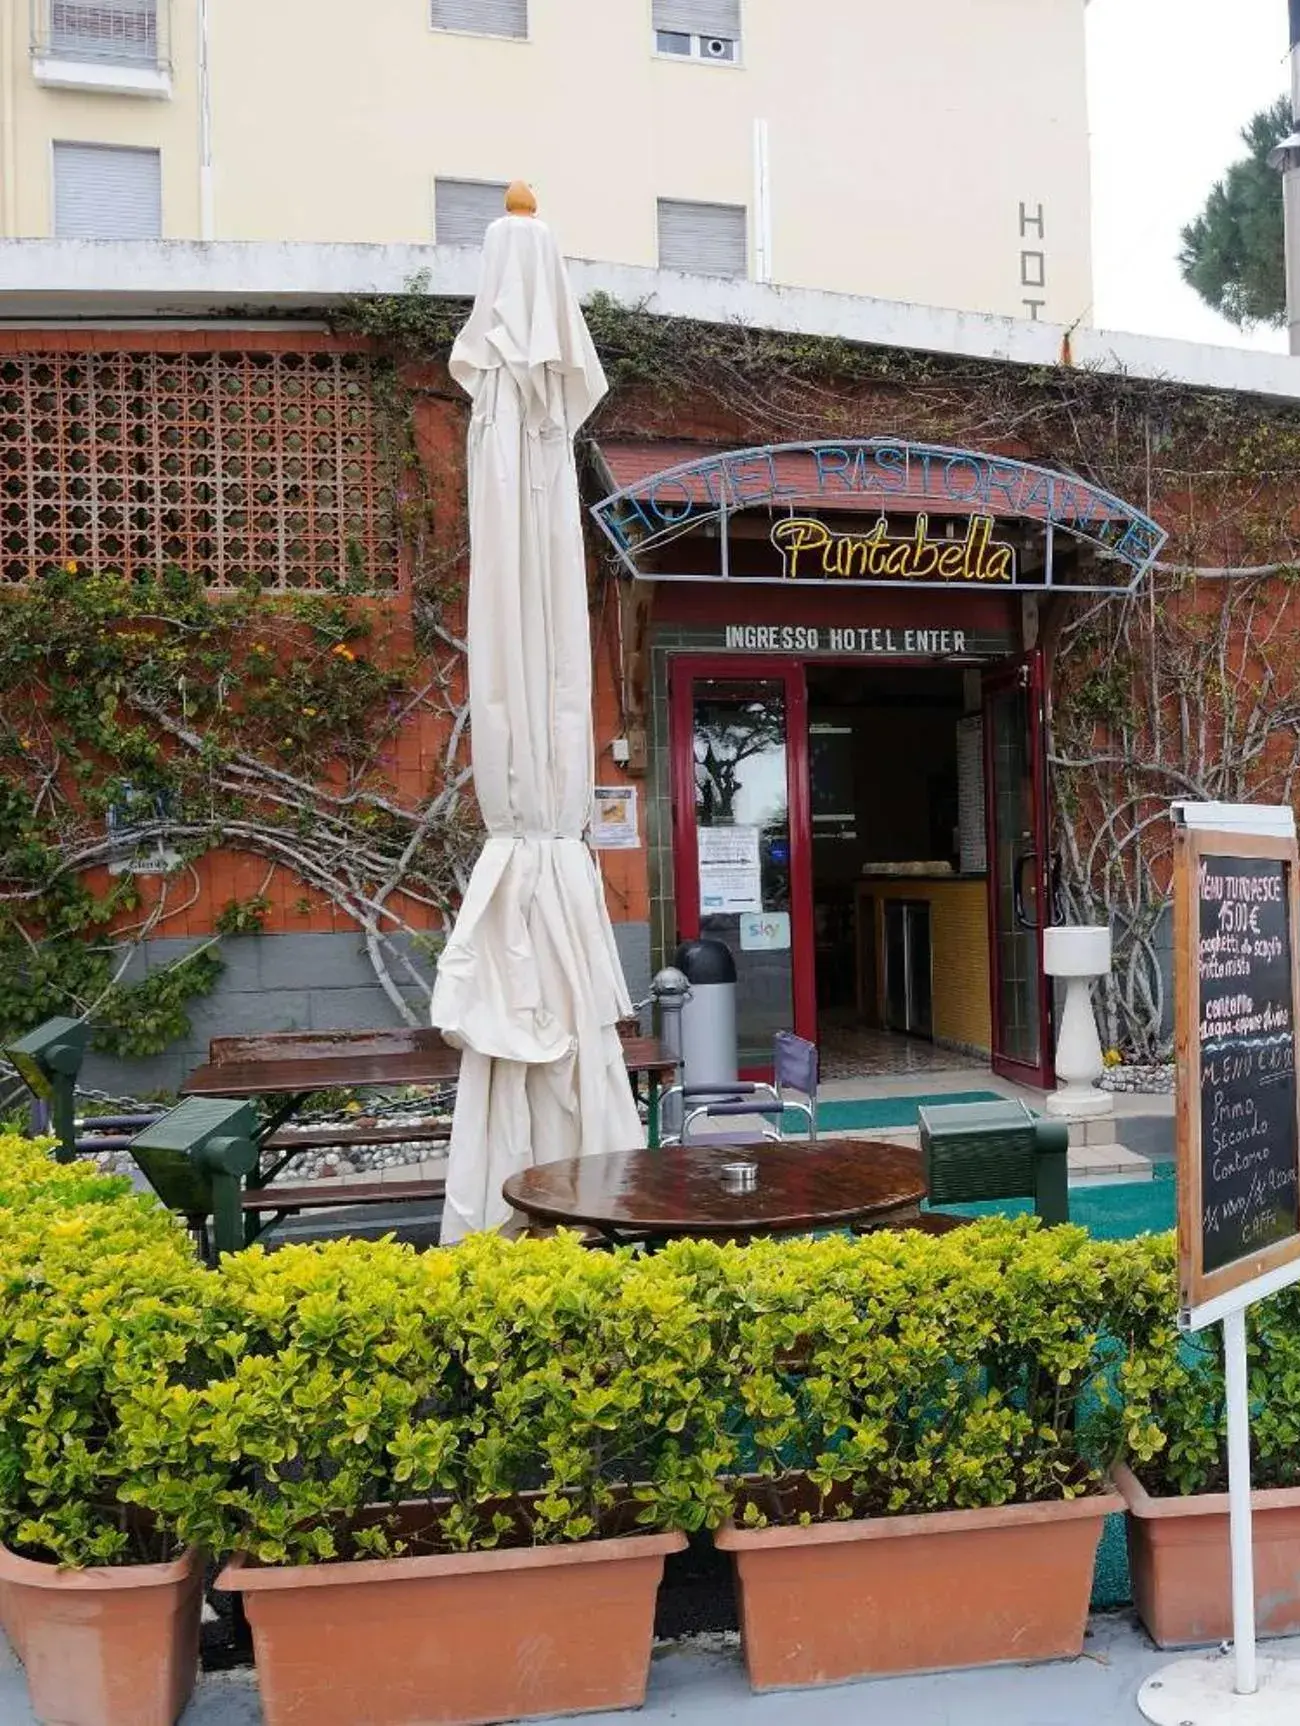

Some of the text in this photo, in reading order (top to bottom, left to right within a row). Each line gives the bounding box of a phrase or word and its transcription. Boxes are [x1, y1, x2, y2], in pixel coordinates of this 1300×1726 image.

[602, 447, 1159, 569] HOTEL RISTORANTE
[774, 516, 1013, 579] Puntabella
[725, 625, 966, 652] INGRESSO HOTEL ENTER
[1212, 1110, 1268, 1156] Secondo
